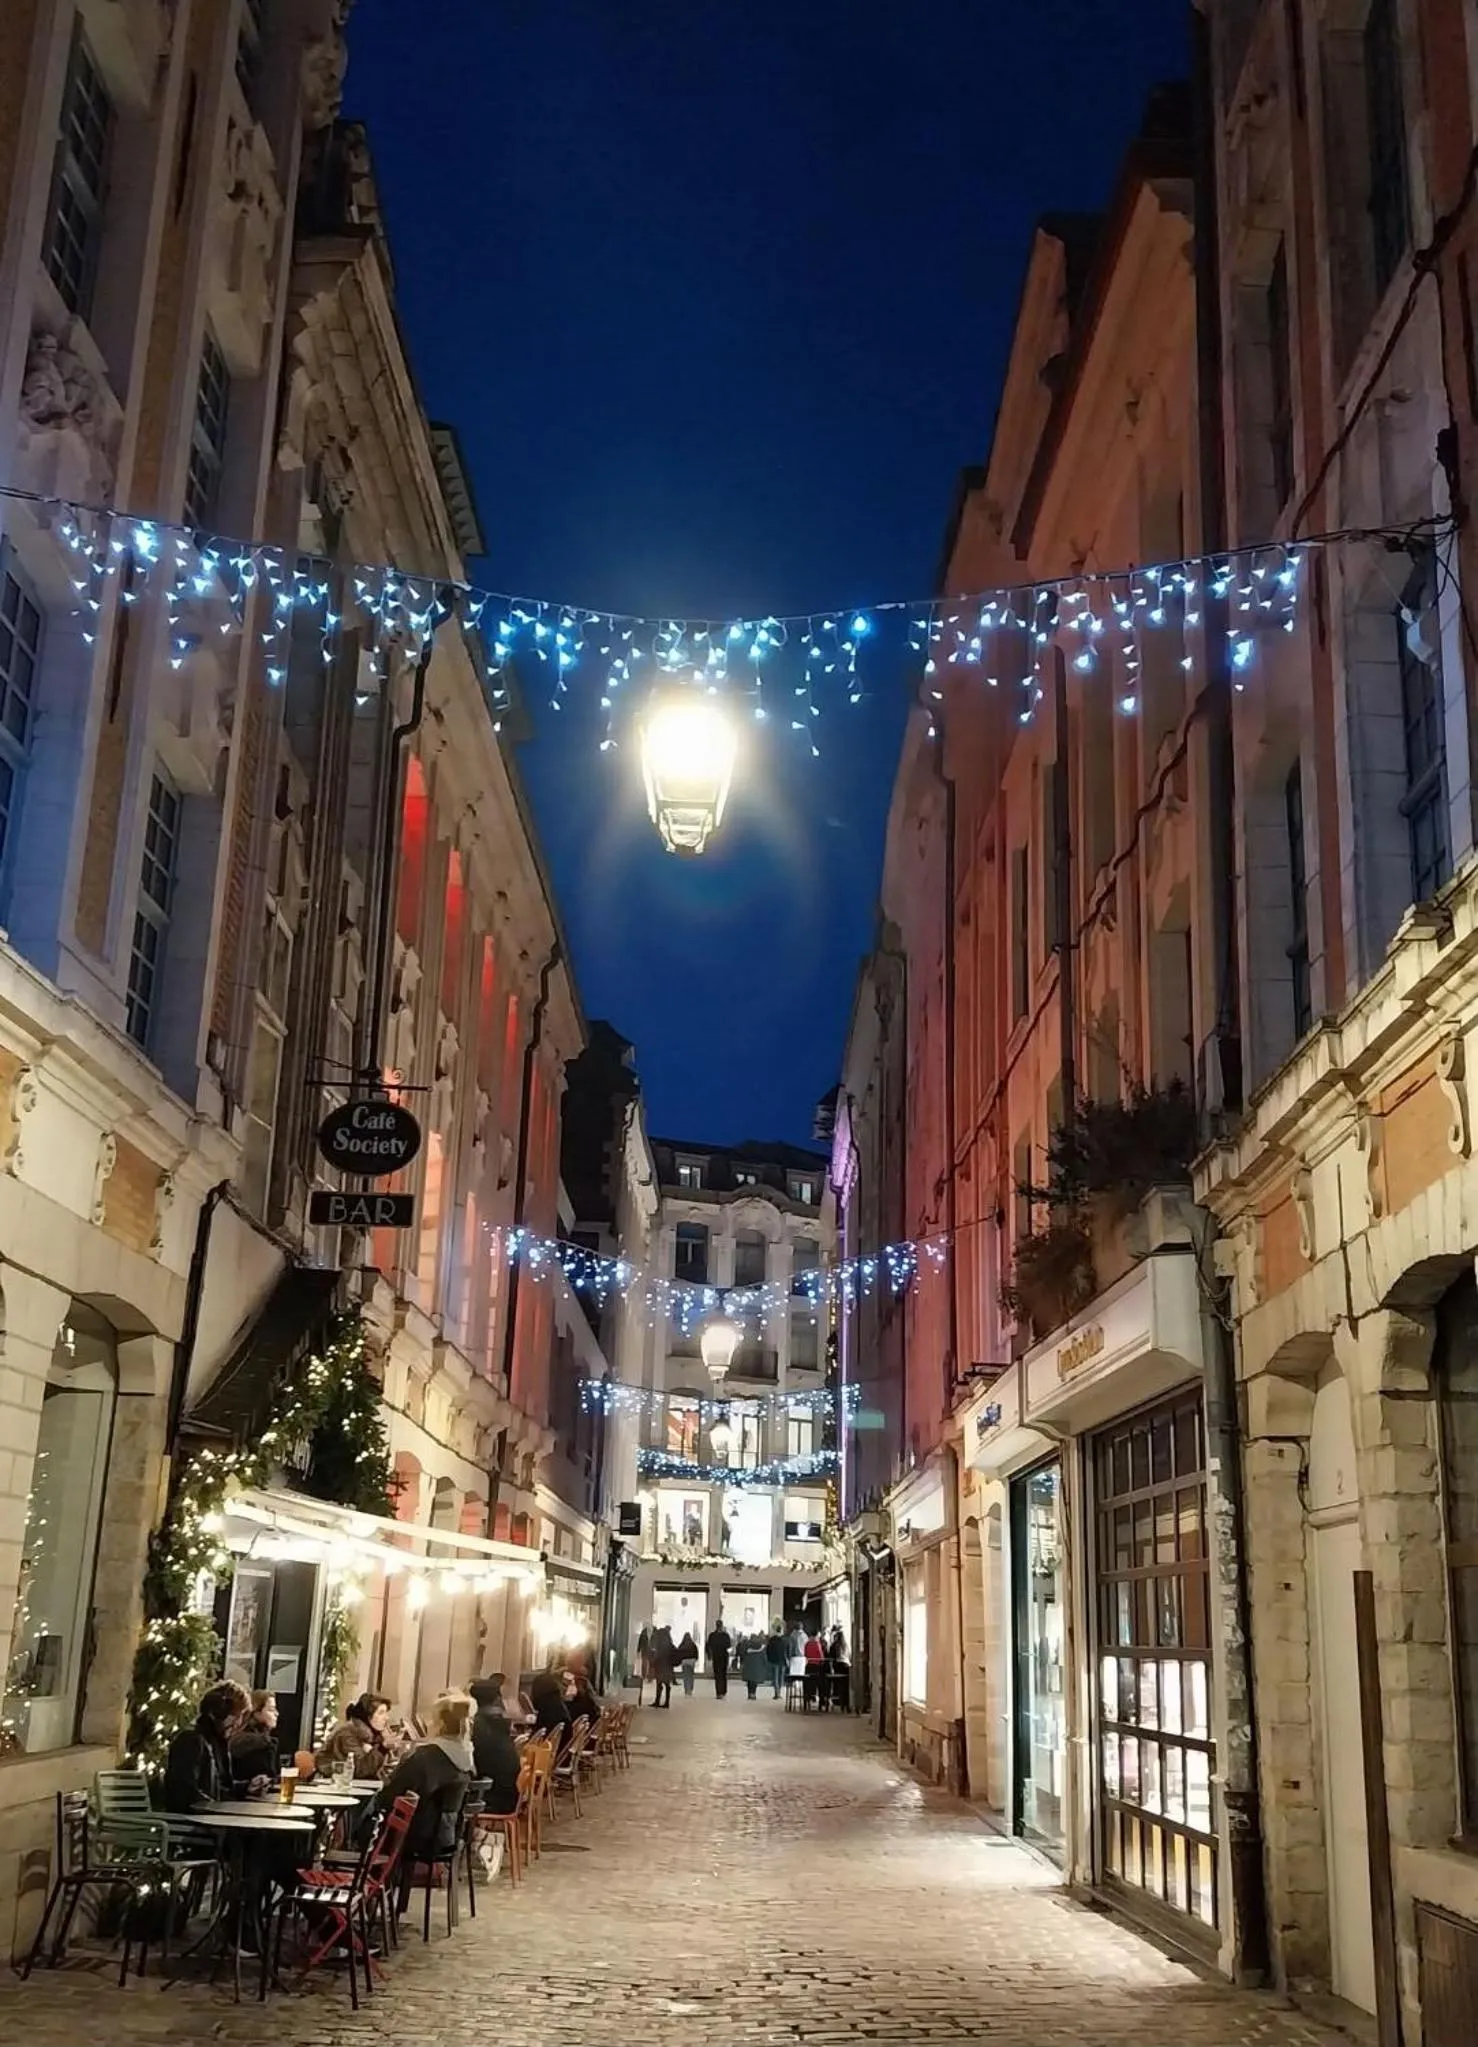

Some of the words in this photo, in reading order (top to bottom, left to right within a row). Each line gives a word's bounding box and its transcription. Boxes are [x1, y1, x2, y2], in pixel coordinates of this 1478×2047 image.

[352, 1106, 396, 1130] Café
[333, 1127, 408, 1157] Society
[328, 1196, 396, 1224] BAR
